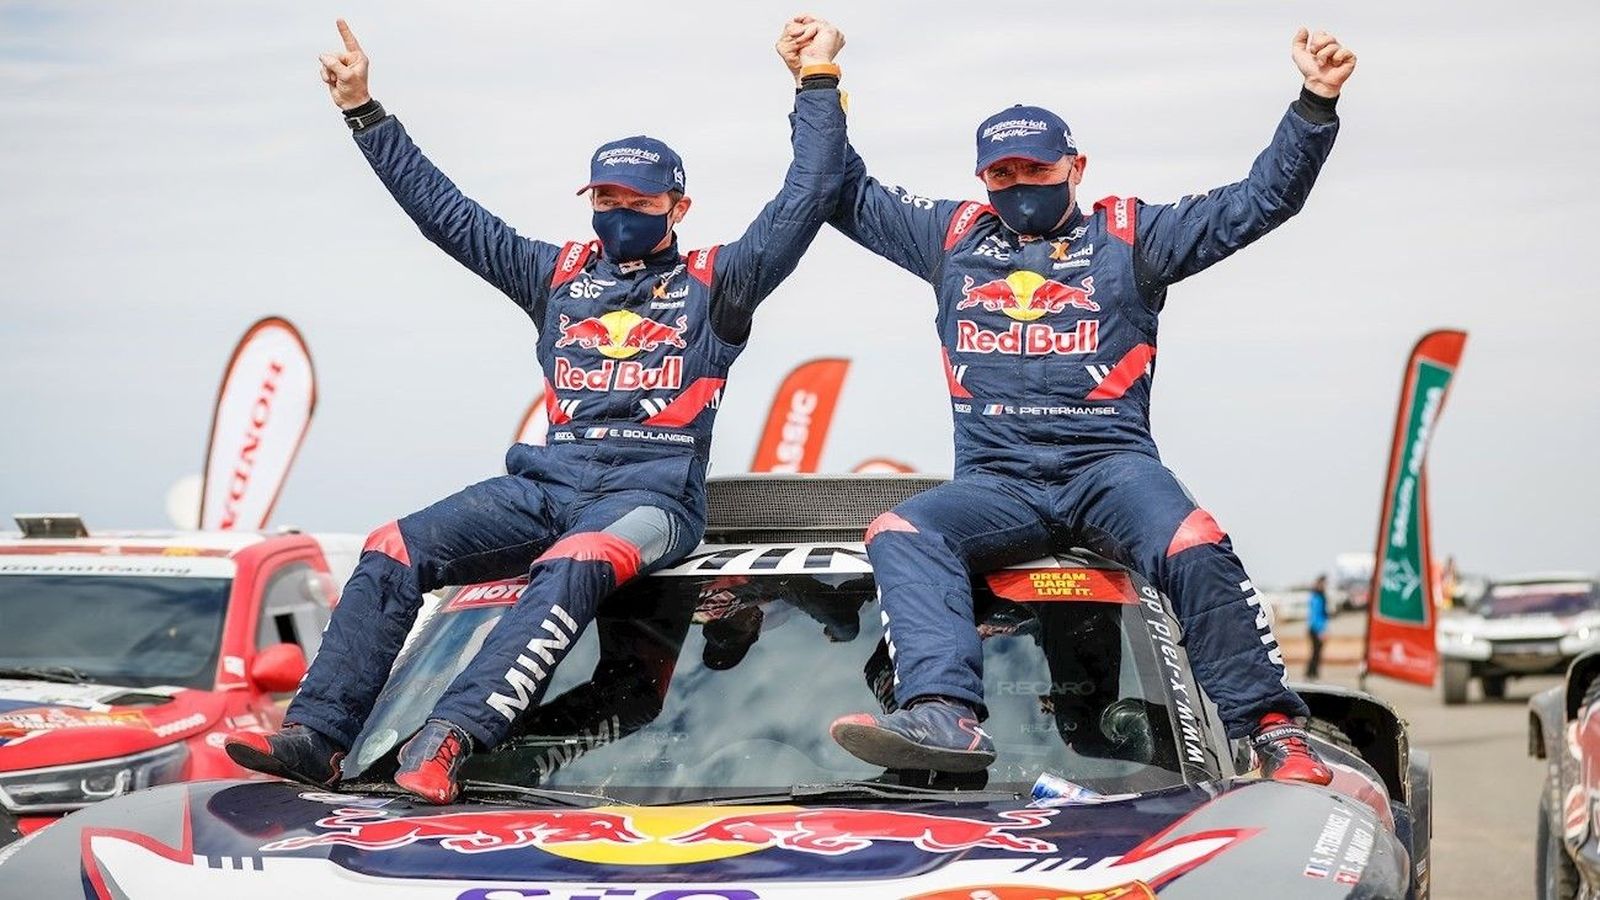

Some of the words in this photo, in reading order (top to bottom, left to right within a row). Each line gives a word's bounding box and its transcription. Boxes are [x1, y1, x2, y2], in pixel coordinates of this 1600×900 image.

[957, 320, 1023, 354] Red
[1025, 320, 1099, 355] Bull
[555, 357, 614, 391] Red
[614, 356, 683, 391] Bull
[1004, 406, 1016, 415] S.
[1019, 406, 1120, 415] PETERHANSEL
[609, 429, 620, 437] E.
[622, 430, 695, 444] BOULANGER
[1030, 573, 1090, 581] DREAM.
[1034, 580, 1080, 588] DARE.
[1037, 588, 1073, 596] LIVE
[486, 604, 579, 723] MINI
[1141, 586, 1205, 764] www.x-raid.de
